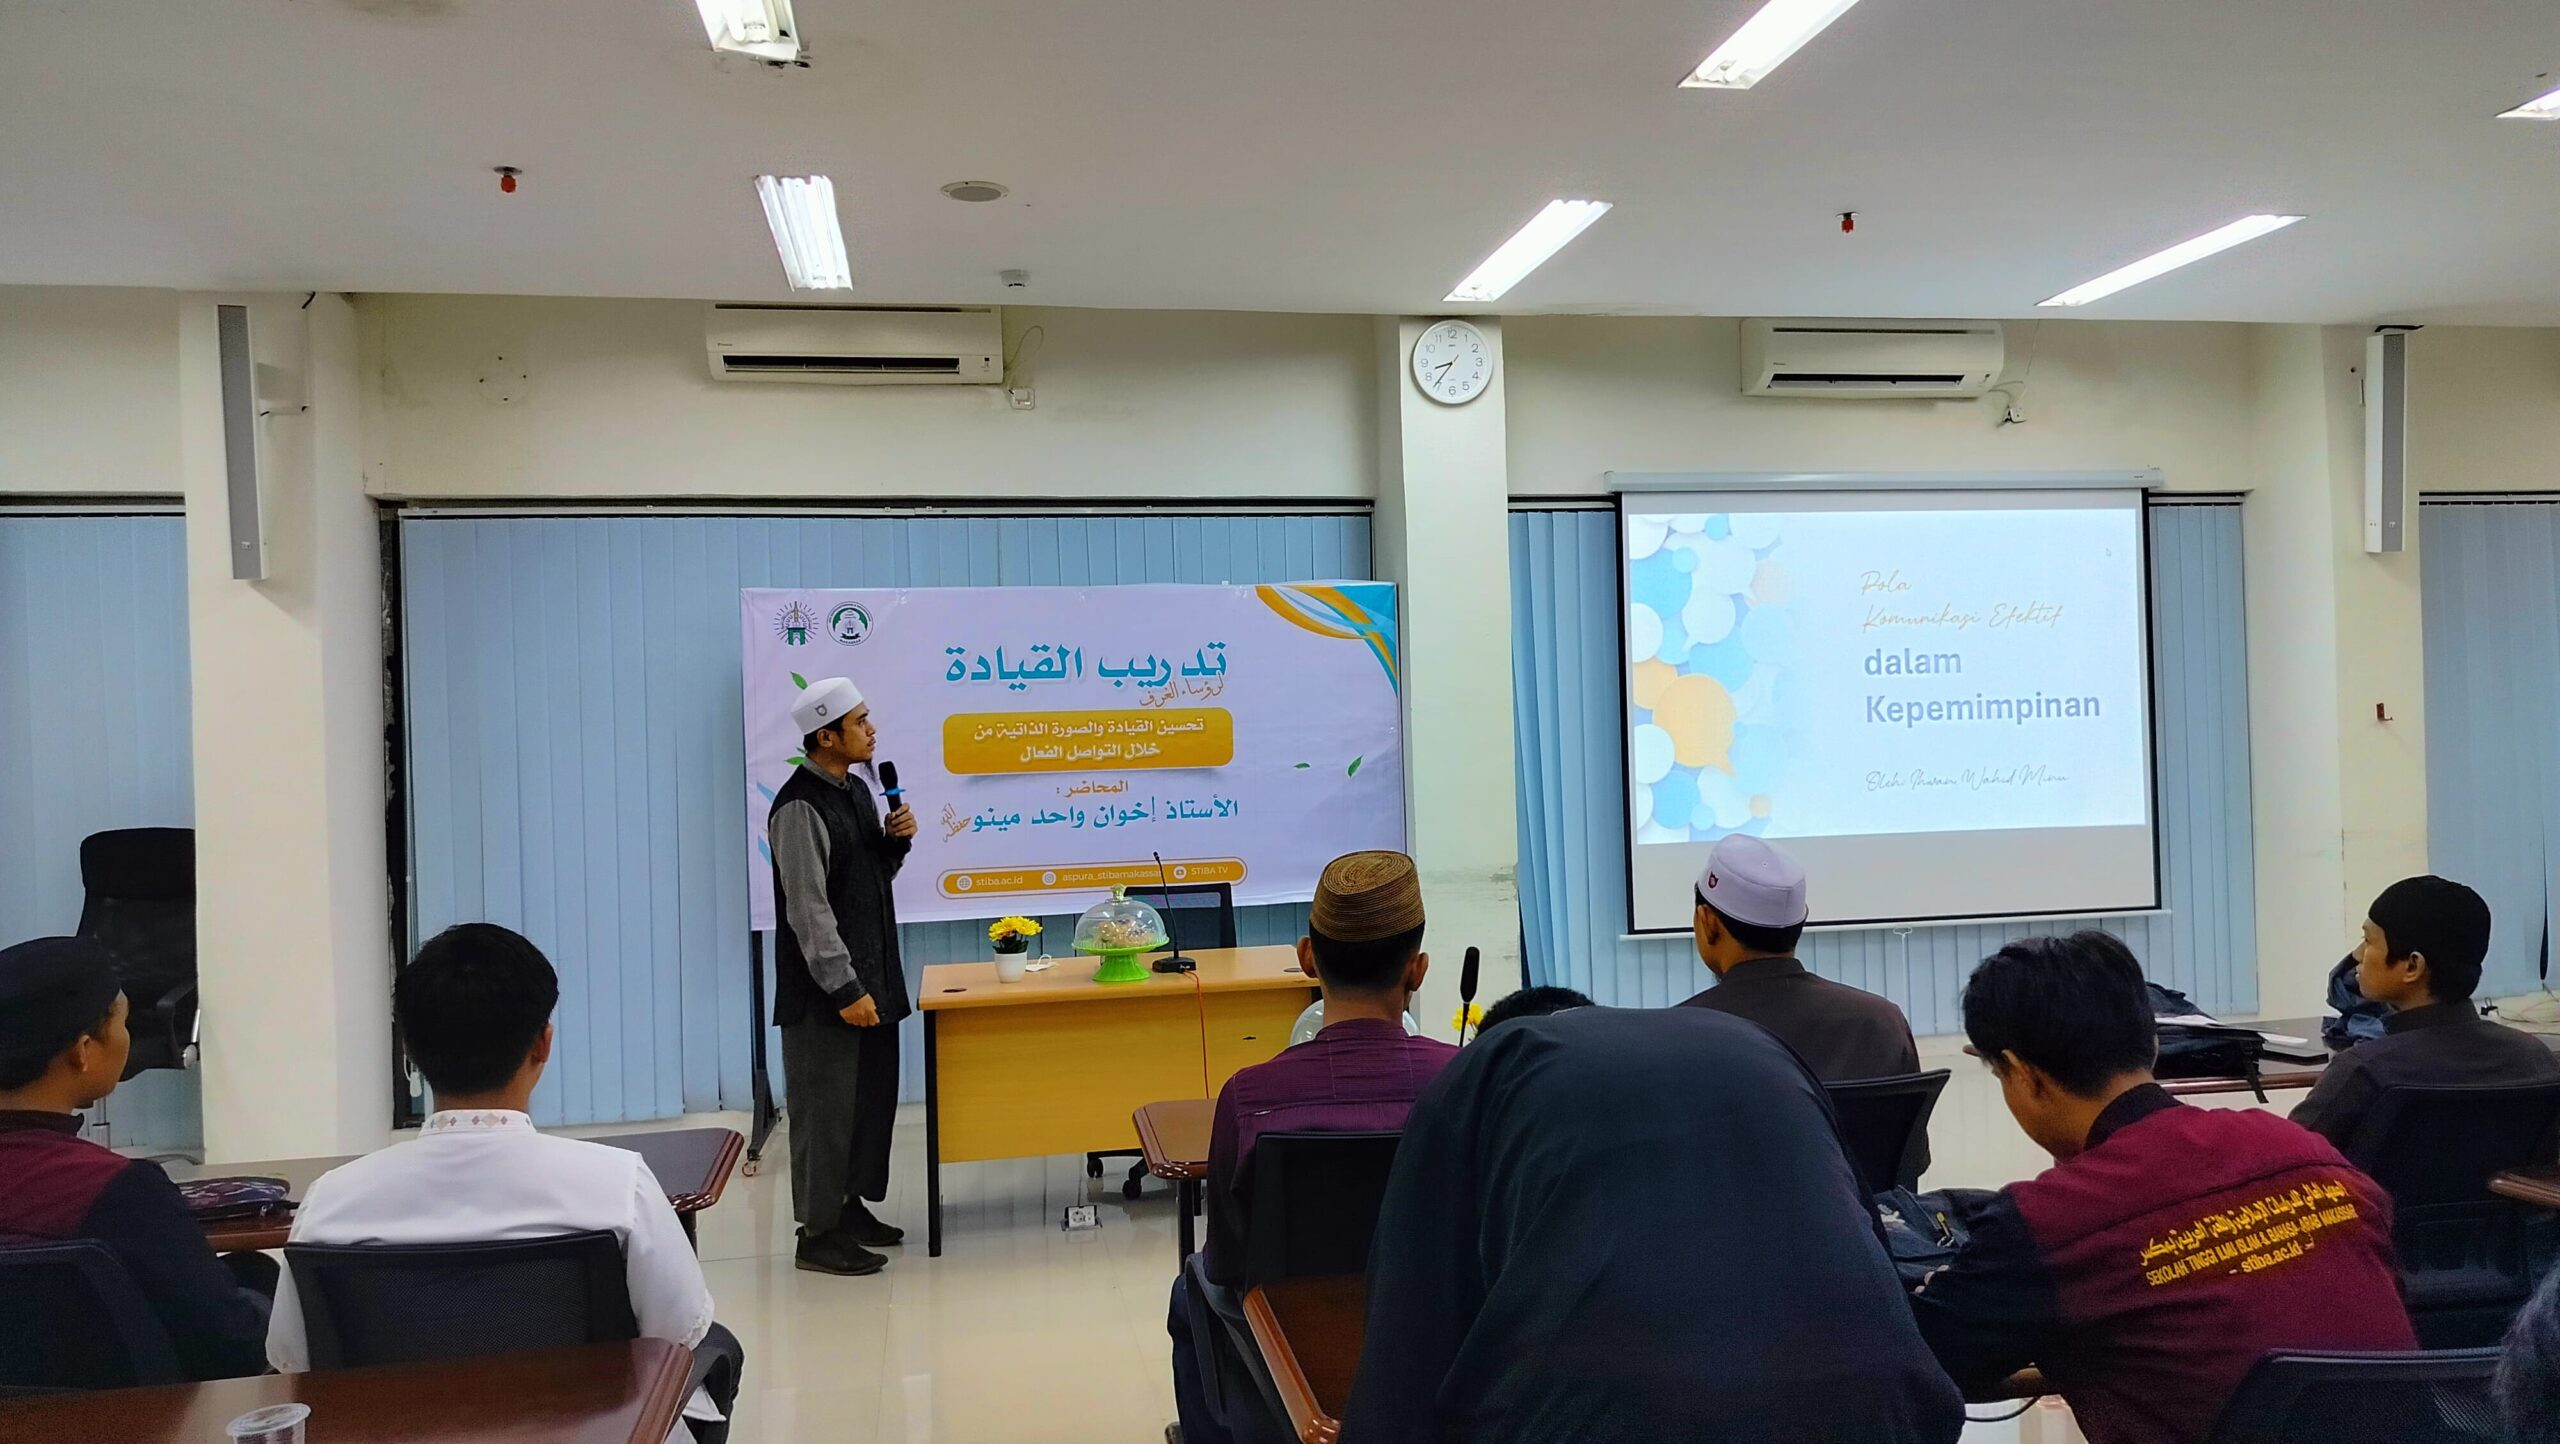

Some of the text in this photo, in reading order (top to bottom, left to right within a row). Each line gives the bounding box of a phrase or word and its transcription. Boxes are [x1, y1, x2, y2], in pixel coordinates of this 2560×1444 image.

[1435, 334, 1442, 343] 11
[1447, 328, 1457, 339] 12
[1425, 343, 1436, 353] 10
[1471, 343, 1479, 353] 2
[1420, 358, 1429, 368] 9
[1475, 357, 1483, 367] 3
[1425, 372, 1432, 381] 8
[1471, 371, 1479, 379] 4
[1448, 386, 1456, 396] 6
[1462, 381, 1470, 391] 5
[1860, 569, 1912, 596] Pola
[1861, 600, 2064, 634] Komunikasi Efektif
[945, 641, 1227, 692] تدريب القيادة
[1863, 647, 1962, 676] dalam
[1865, 691, 2101, 729] Kepemimpinan
[973, 717, 1204, 740] تحسين القيادة والصورة الذاتية من
[1019, 742, 1161, 763] خلال التواصل الفعال
[1065, 779, 1129, 798] المحاضر
[971, 794, 1239, 833] الأستاذ إخوان واحد مينو
[1190, 865, 1229, 876] STIBA TV
[975, 875, 1024, 887] stiba.ac.id
[2145, 1259, 2190, 1287] SEKOLAH
[2186, 1248, 2219, 1272] TINGGI
[2266, 1221, 2300, 1243] BAHASA
[2240, 1240, 2304, 1274] stiba.ac.id
